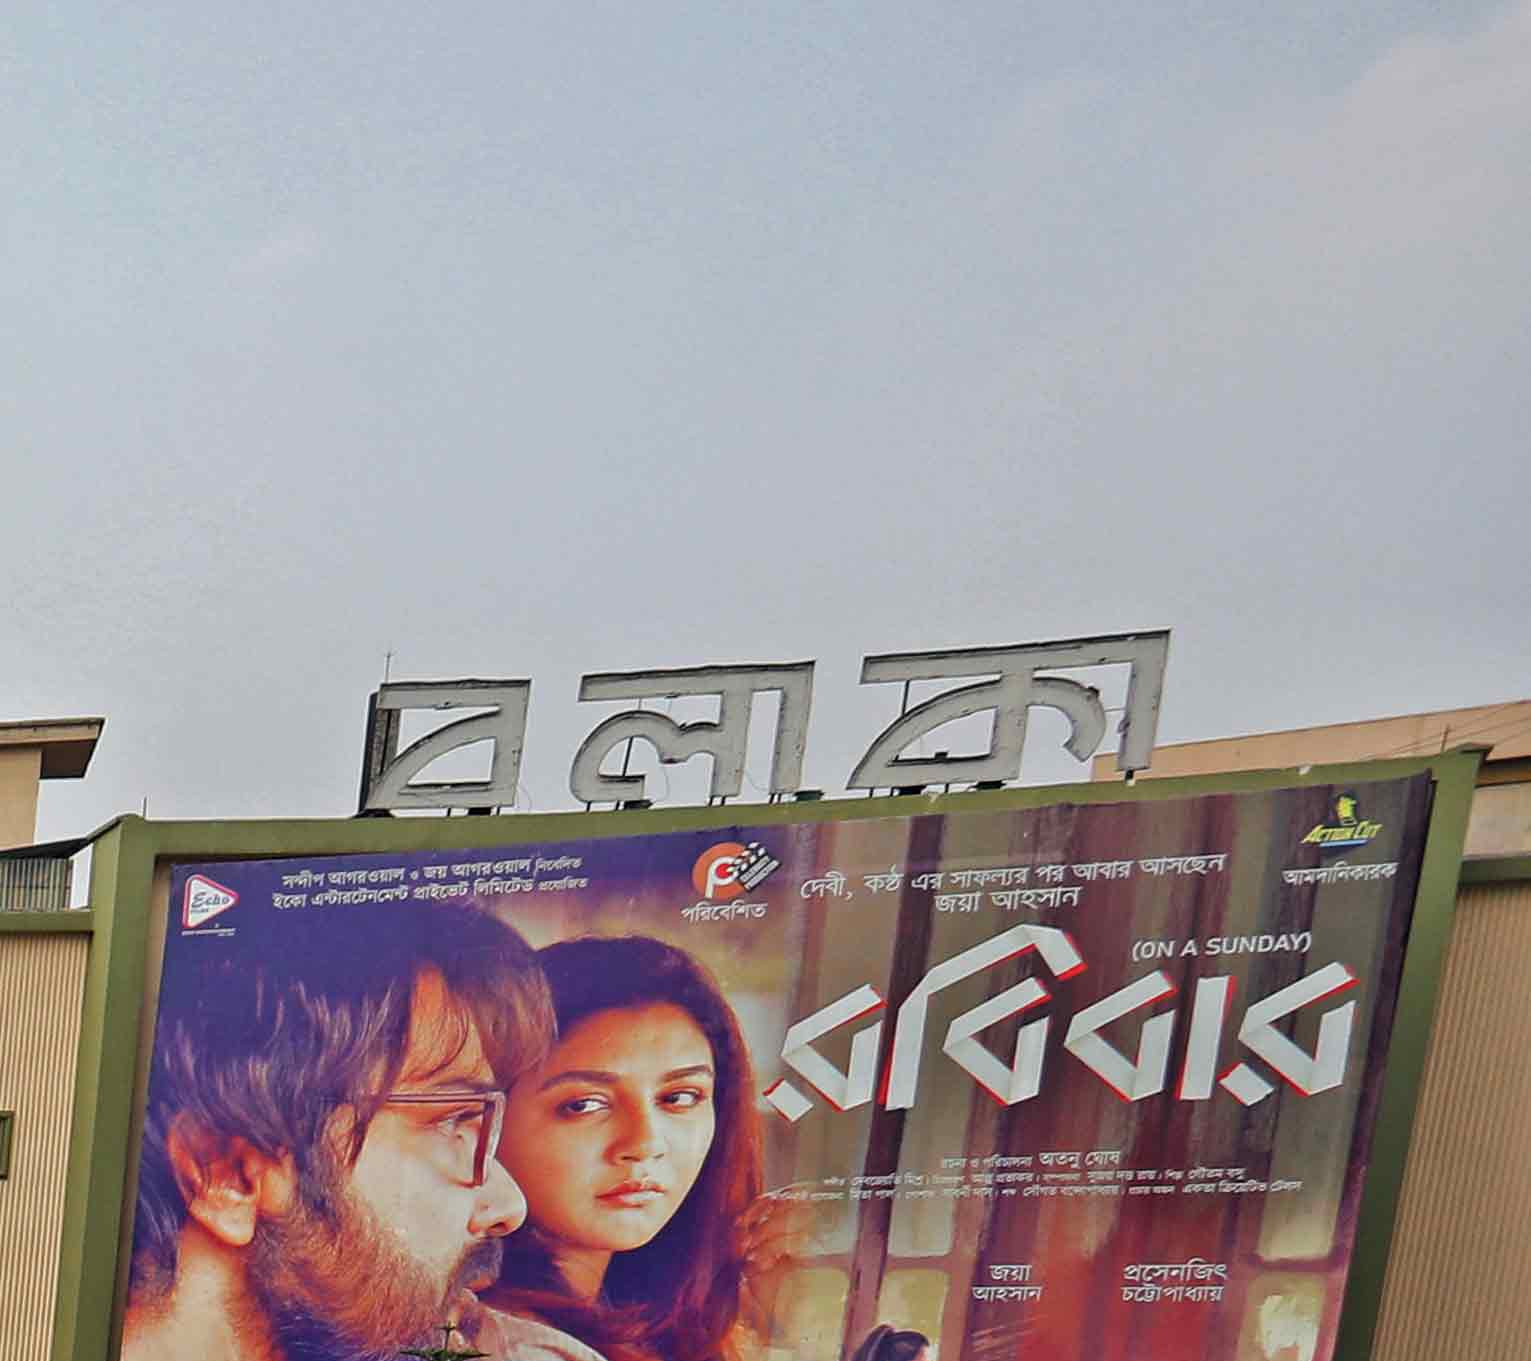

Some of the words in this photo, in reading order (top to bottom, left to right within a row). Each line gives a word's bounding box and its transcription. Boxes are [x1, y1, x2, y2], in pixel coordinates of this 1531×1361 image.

[364, 629, 1172, 810] বলাকা
[911, 873, 942, 891] এর
[1072, 859, 1131, 882] আবার
[1140, 853, 1227, 878] আসছেন
[681, 899, 769, 923] পরিবেশিত
[935, 891, 981, 913] জয়া
[991, 886, 1082, 911] আহসান
[1132, 940, 1176, 961] (ON
[1179, 940, 1200, 958] A
[1205, 931, 1313, 955] SUNDAY)
[763, 922, 1364, 1123] রবিবার
[990, 1264, 1032, 1281] জয়া
[1123, 1258, 1227, 1282] প্রসেনজিৎ
[972, 1285, 1042, 1302] আহসান
[1121, 1285, 1224, 1303] চট্টোপাধ্যায়
